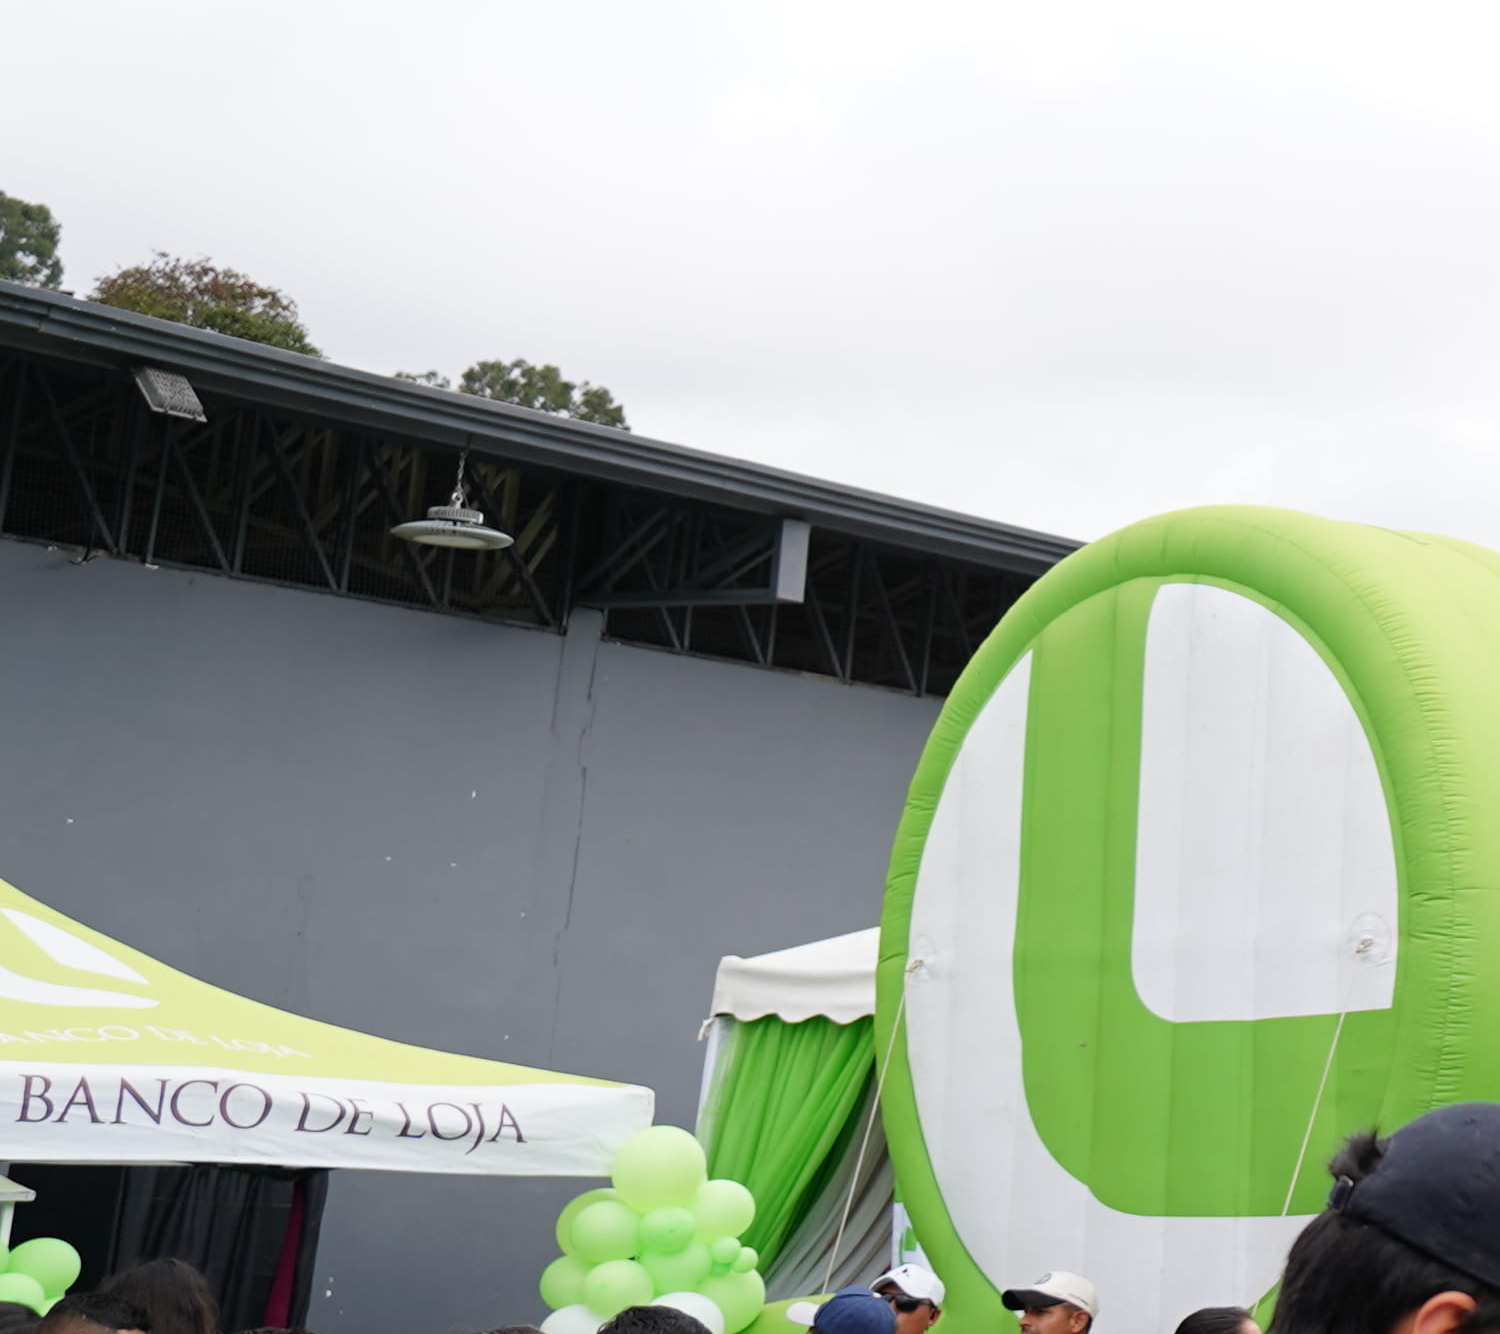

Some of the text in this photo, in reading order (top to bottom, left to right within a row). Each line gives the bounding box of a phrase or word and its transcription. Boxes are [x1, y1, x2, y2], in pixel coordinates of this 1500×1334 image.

[0, 1025, 139, 1044] ANCO
[15, 1073, 527, 1154] BANCO DE LOJA
